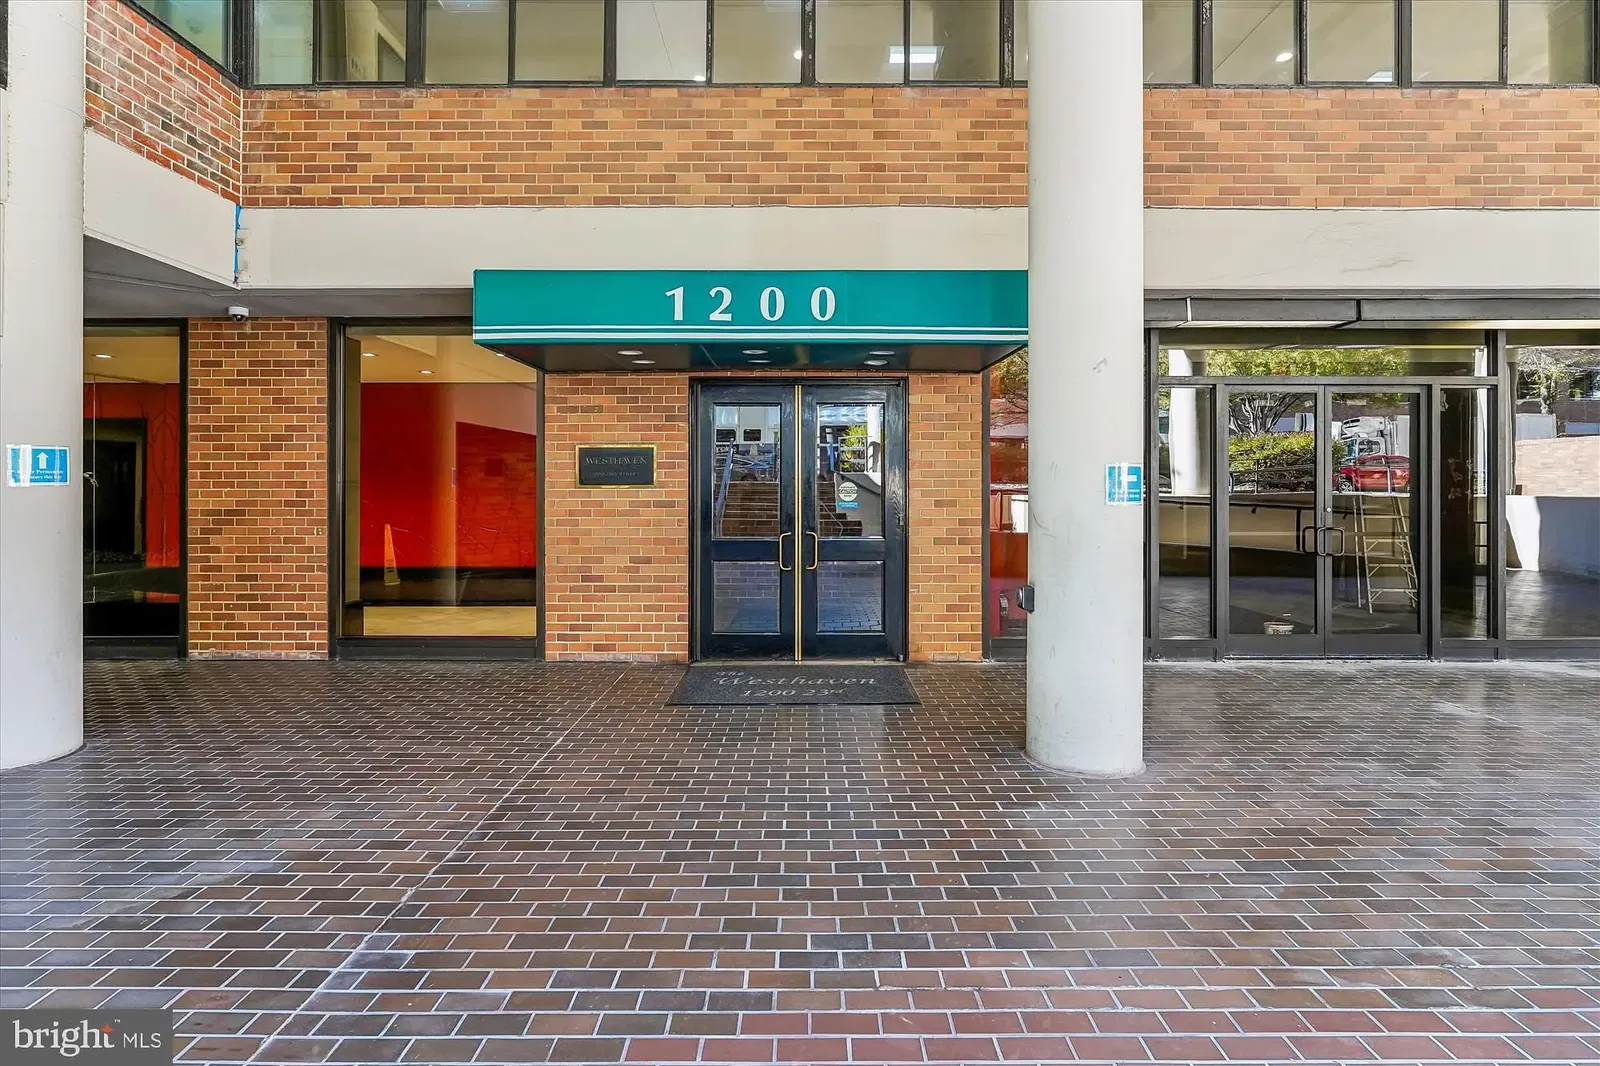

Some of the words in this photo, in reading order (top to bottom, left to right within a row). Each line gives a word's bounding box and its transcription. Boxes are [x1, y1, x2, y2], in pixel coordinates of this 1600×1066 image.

[665, 286, 836, 321] 1200
[585, 456, 647, 465] WESTHAVEN
[713, 675, 878, 685] Westhaven
[741, 689, 796, 697] 1200
